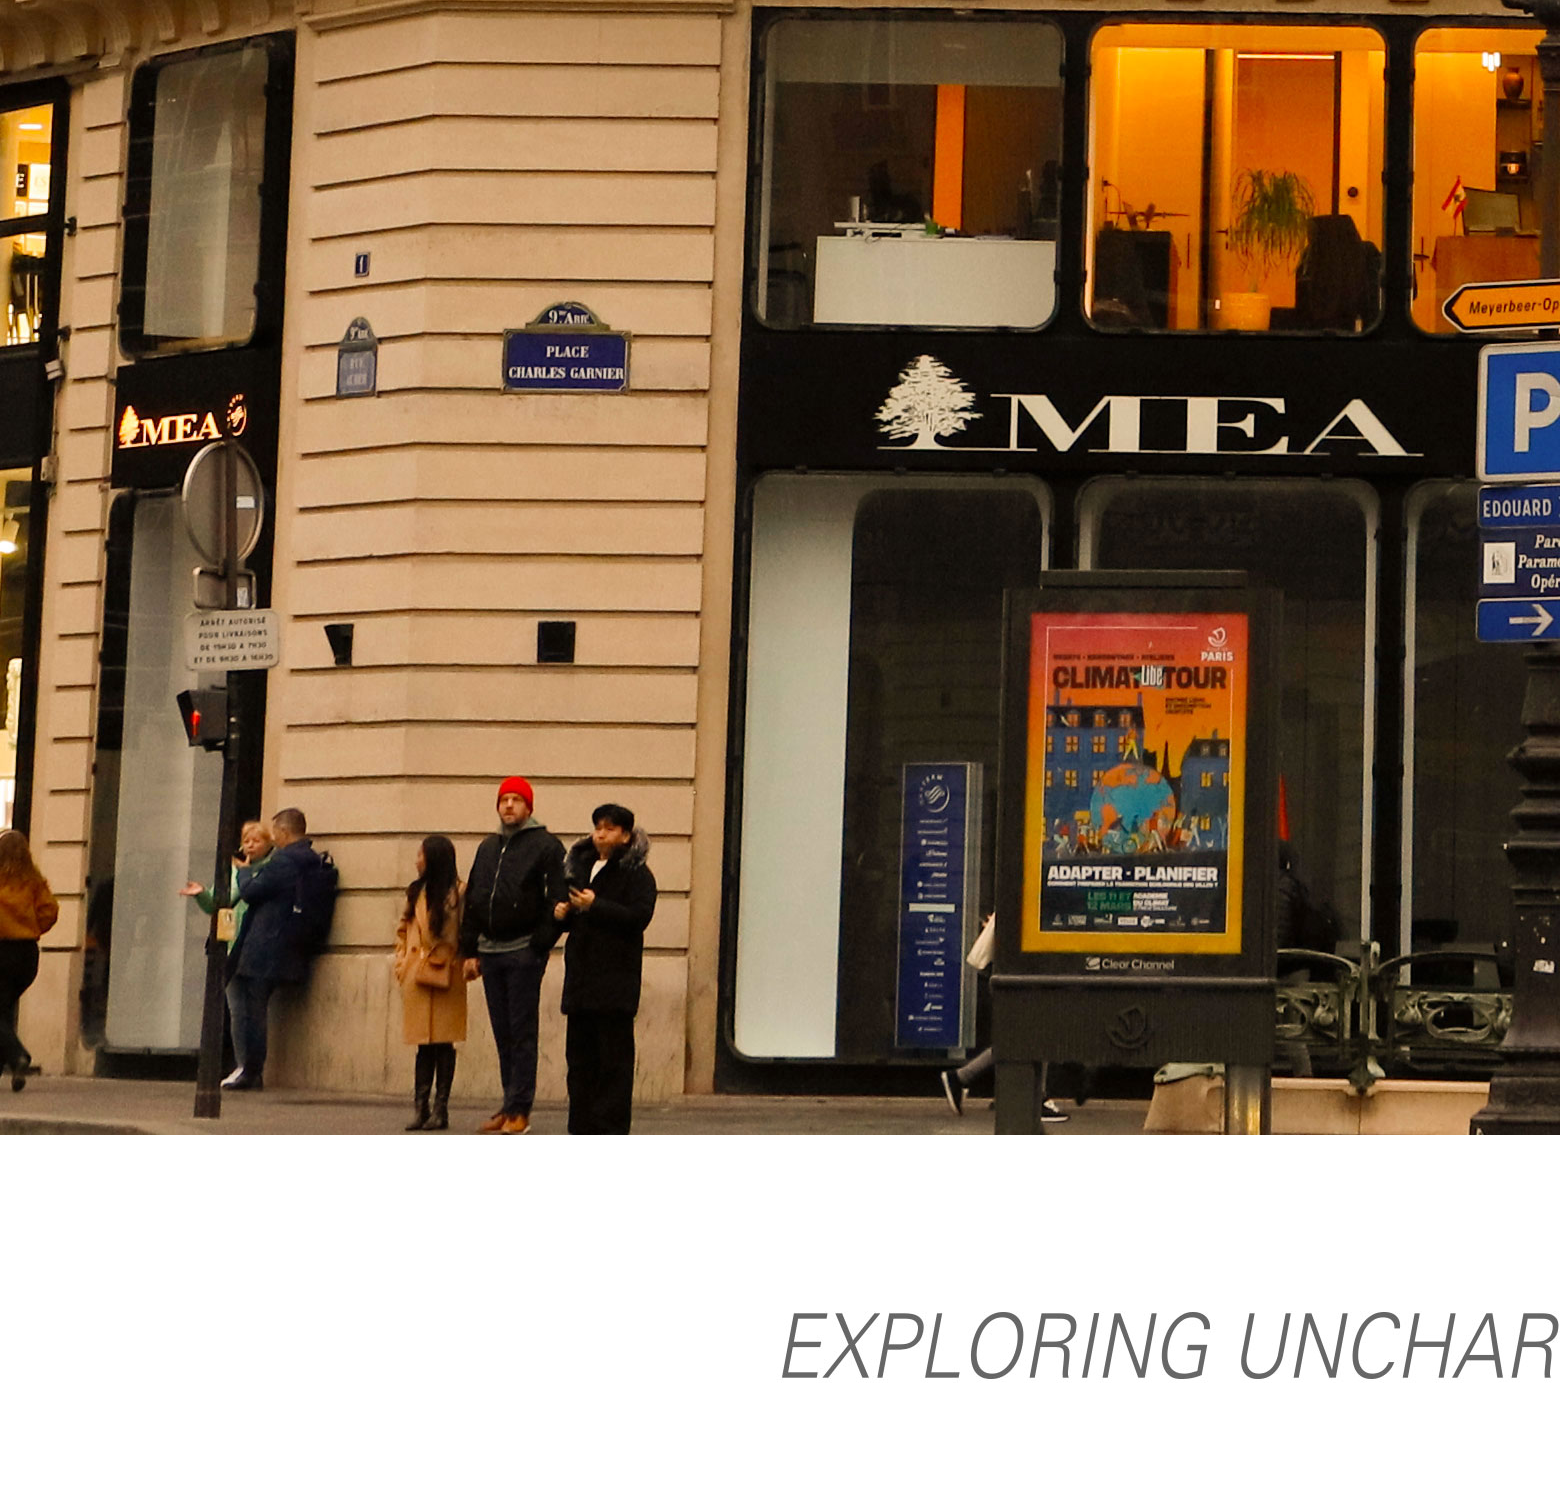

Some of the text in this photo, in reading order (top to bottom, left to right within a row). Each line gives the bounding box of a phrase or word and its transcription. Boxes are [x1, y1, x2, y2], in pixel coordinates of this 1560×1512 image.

[546, 345, 590, 358] PLACE
[509, 366, 624, 380] CHARLES GARNIER
[140, 412, 222, 445] MEA
[991, 393, 1424, 457] MEA
[1483, 499, 1552, 518] EDOUARD
[1201, 651, 1234, 662] PARIS
[1053, 666, 1141, 690] CLIMAT
[1163, 666, 1227, 690] TOUR
[1048, 866, 1218, 881] ADAPTER PLANIFIER
[1102, 959, 1175, 970] Clear Channel
